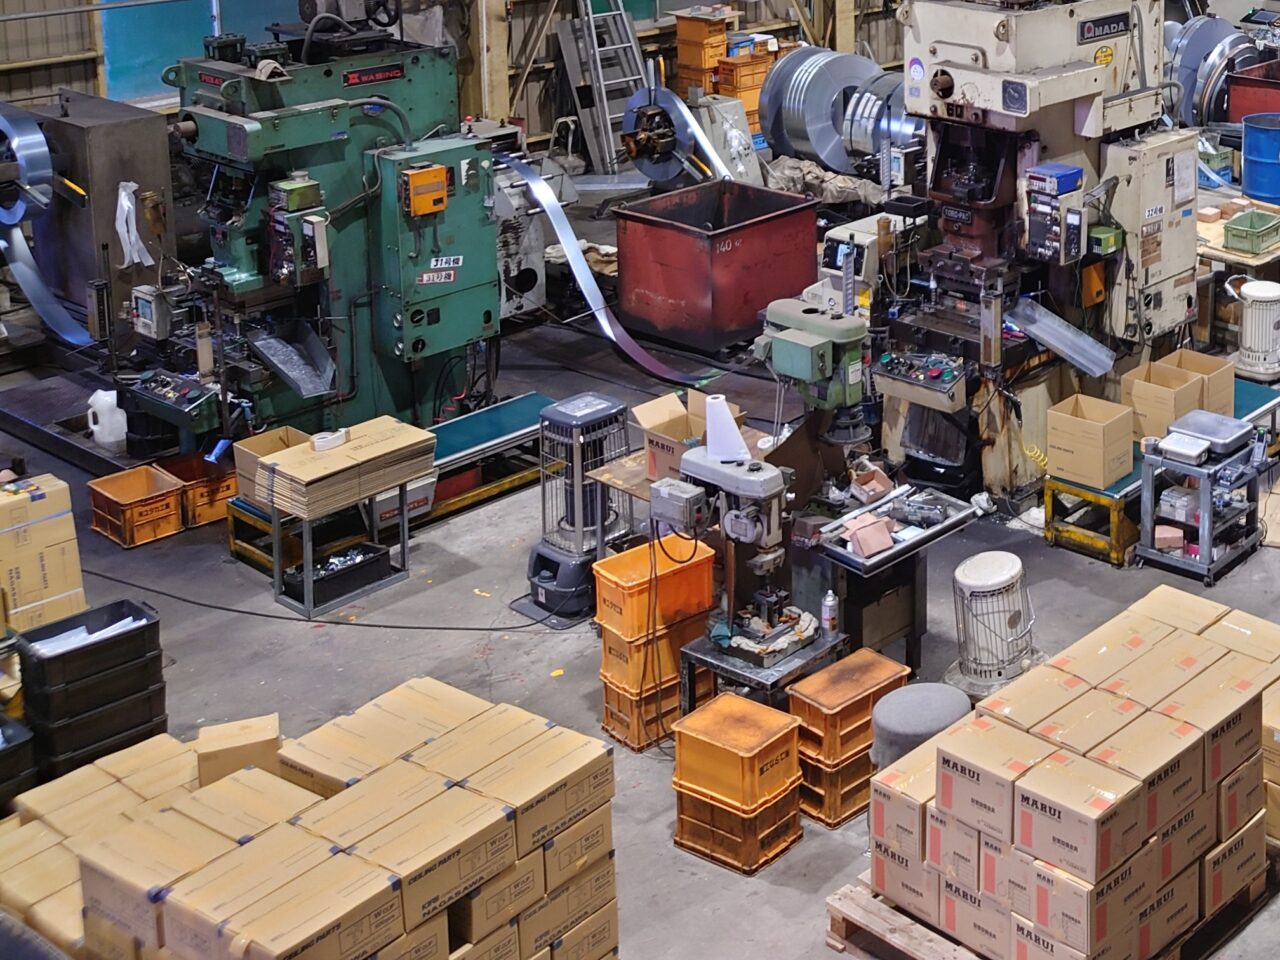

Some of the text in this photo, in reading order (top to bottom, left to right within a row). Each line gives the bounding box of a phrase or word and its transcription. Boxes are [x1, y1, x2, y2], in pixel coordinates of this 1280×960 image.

[1084, 22, 1125, 38] AMADA
[648, 438, 674, 454] MARUI
[1211, 712, 1241, 741] MARUI
[942, 756, 981, 782] MARUI
[1147, 760, 1181, 790] MARUI
[1020, 793, 1062, 820] MARUI
[1162, 809, 1194, 841] MARUI
[408, 848, 461, 886] CEILING PARTS
[875, 840, 909, 868] MARUI
[1213, 837, 1244, 870] MARUI
[422, 876, 485, 919] NAGASAWA
[945, 879, 982, 908] MARUI
[1095, 866, 1132, 901] MARUI
[1139, 887, 1175, 921] MARUI
[1016, 923, 1055, 953] MARUI
